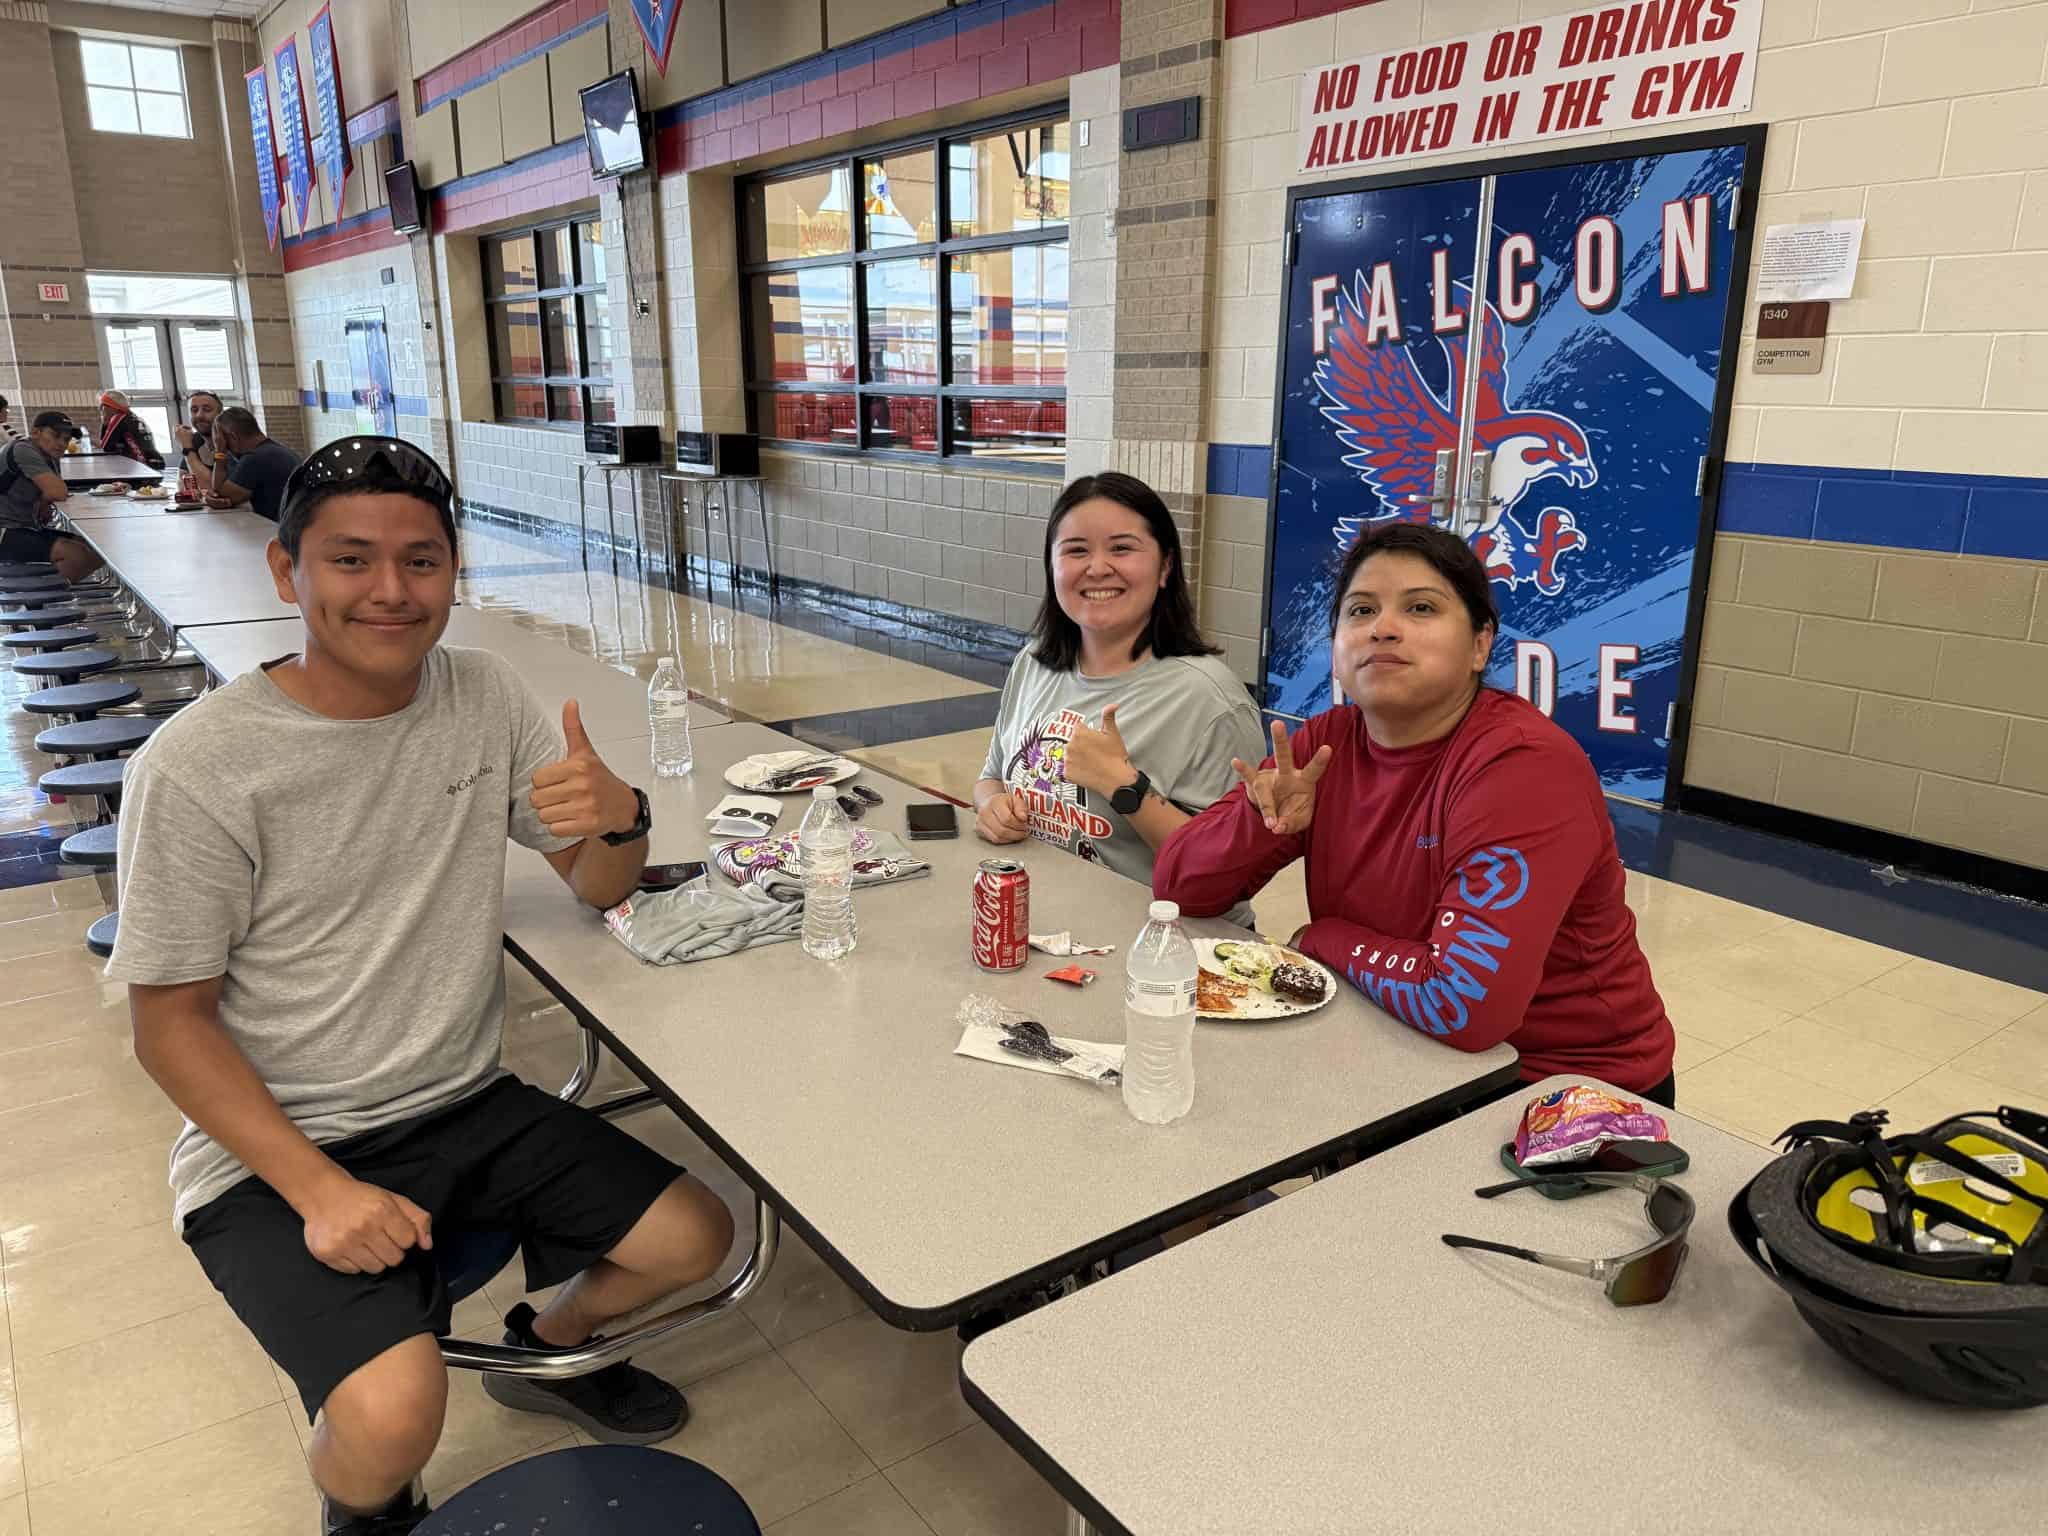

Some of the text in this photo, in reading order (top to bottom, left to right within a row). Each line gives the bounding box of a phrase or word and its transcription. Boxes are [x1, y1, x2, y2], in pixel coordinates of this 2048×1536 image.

[1313, 0, 1738, 115] NO FOOD OR DRINKS
[1305, 52, 1745, 169] ALLOWED IN THE GYM
[1311, 193, 1713, 355] FALCON
[44, 285, 64, 299] EXIT
[1763, 308, 1789, 320] 1340
[1756, 357, 1775, 366] GYM
[1757, 349, 1811, 359] COMPETITION
[457, 765, 493, 792] Colbia
[1014, 787, 1112, 838] ATLAND
[1027, 814, 1071, 839] ENTURY
